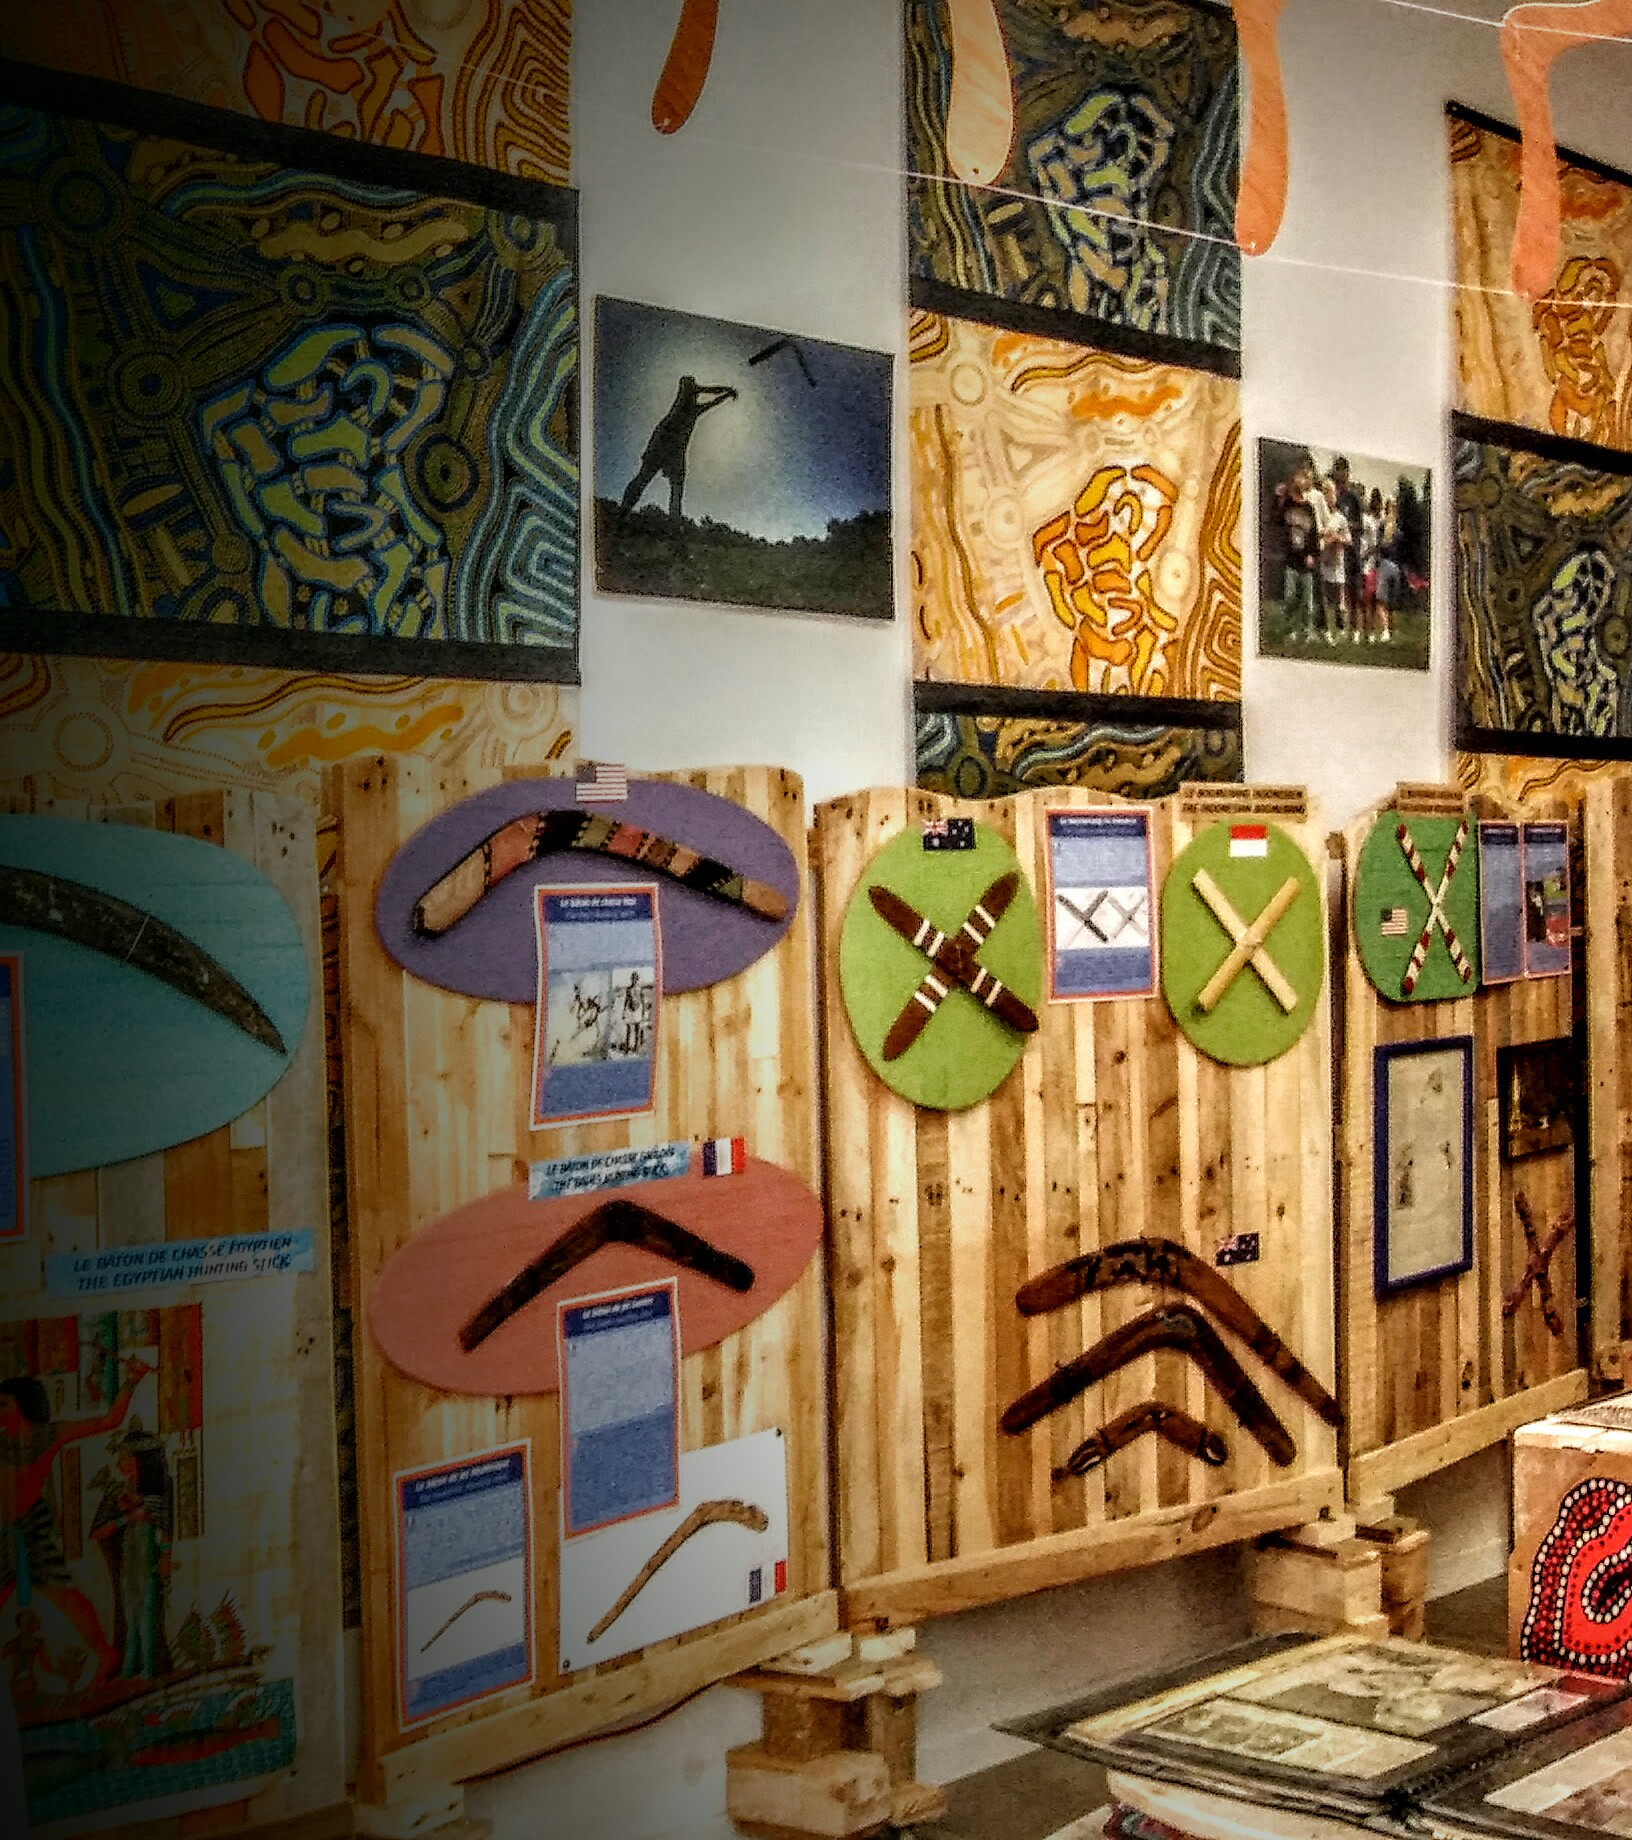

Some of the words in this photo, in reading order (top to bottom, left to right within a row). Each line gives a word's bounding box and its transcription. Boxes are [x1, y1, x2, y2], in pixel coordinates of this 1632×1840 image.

[73, 1257, 92, 1273] LE
[149, 1250, 167, 1264] DE
[172, 1240, 224, 1262] CHASSE
[78, 1275, 107, 1292] THE
[113, 1267, 184, 1288] EGYPTIAN
[187, 1259, 248, 1279] HUNTING
[253, 1253, 291, 1272] STICK
